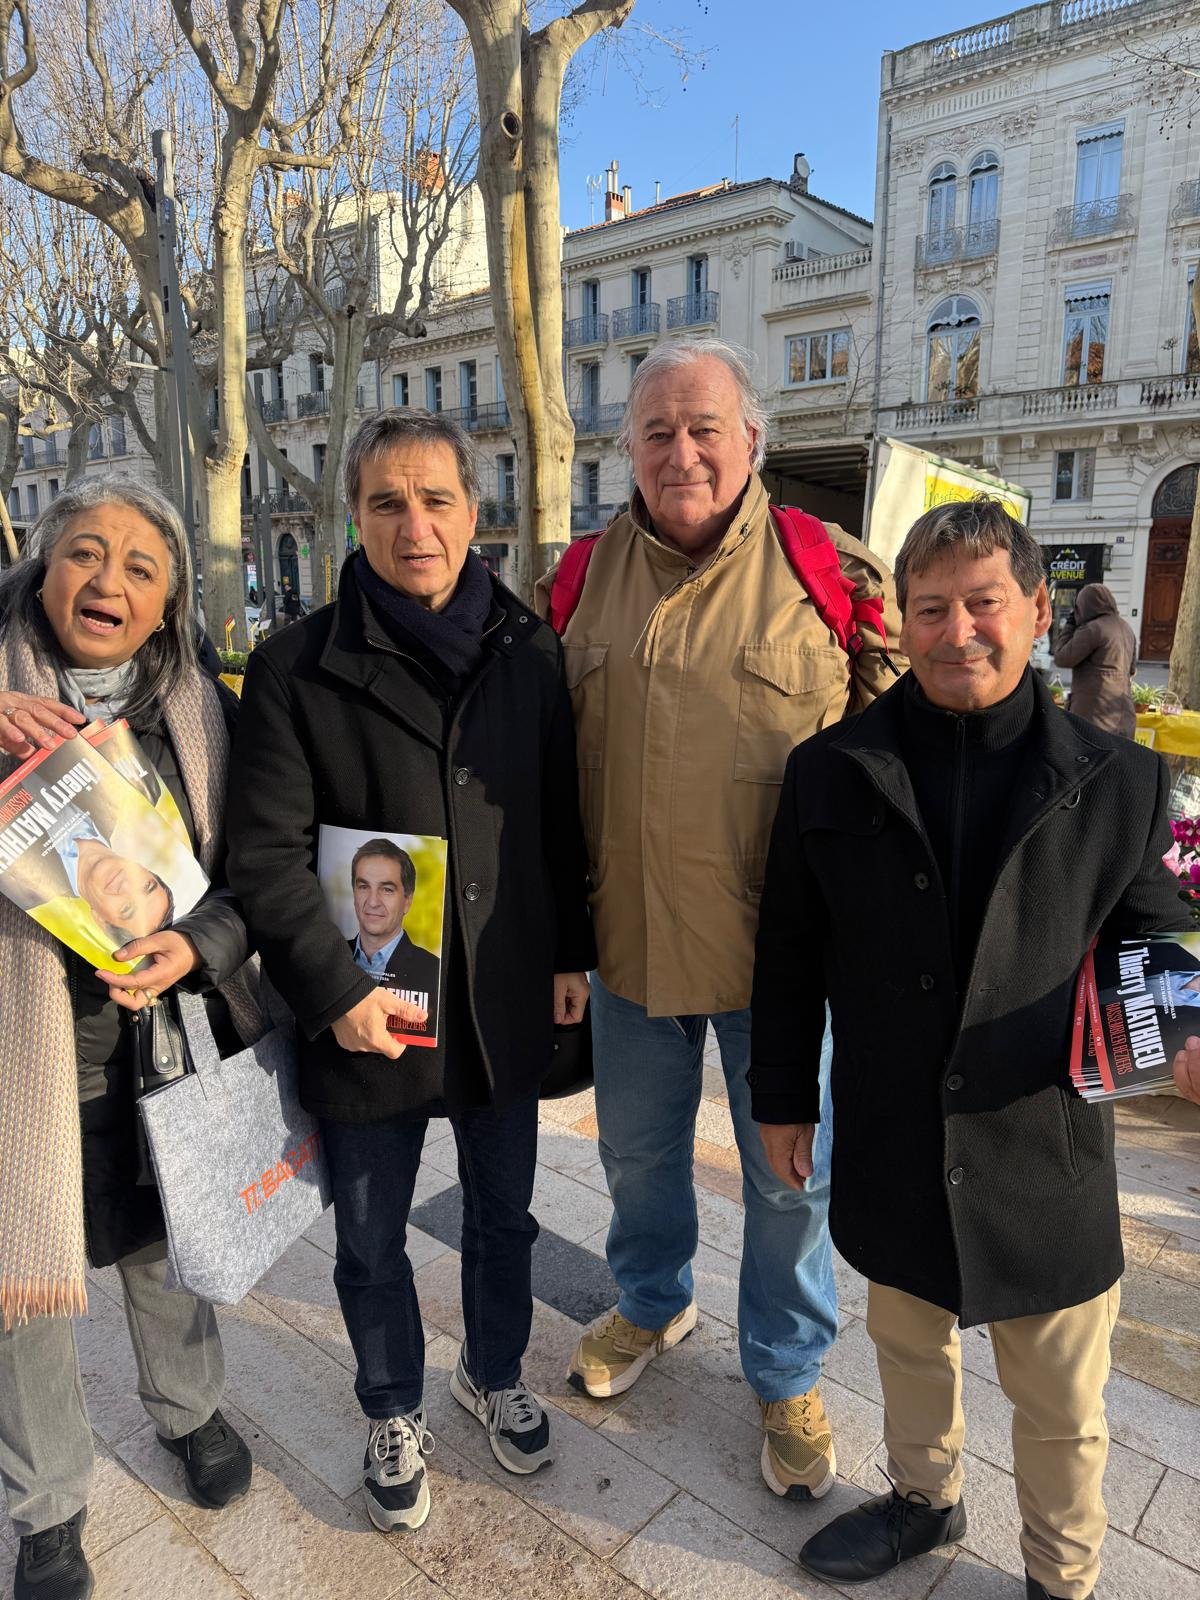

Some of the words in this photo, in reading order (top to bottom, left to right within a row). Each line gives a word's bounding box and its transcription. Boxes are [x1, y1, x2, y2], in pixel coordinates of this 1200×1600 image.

[1050, 558, 1086, 570] CRÉDIT
[1050, 570, 1085, 579] AVENUE
[40, 757, 101, 813] Thierry
[1117, 946, 1150, 995] Thierry
[1105, 1002, 1127, 1046] RASSEMBLER
[1123, 993, 1167, 1070] MATHIEU
